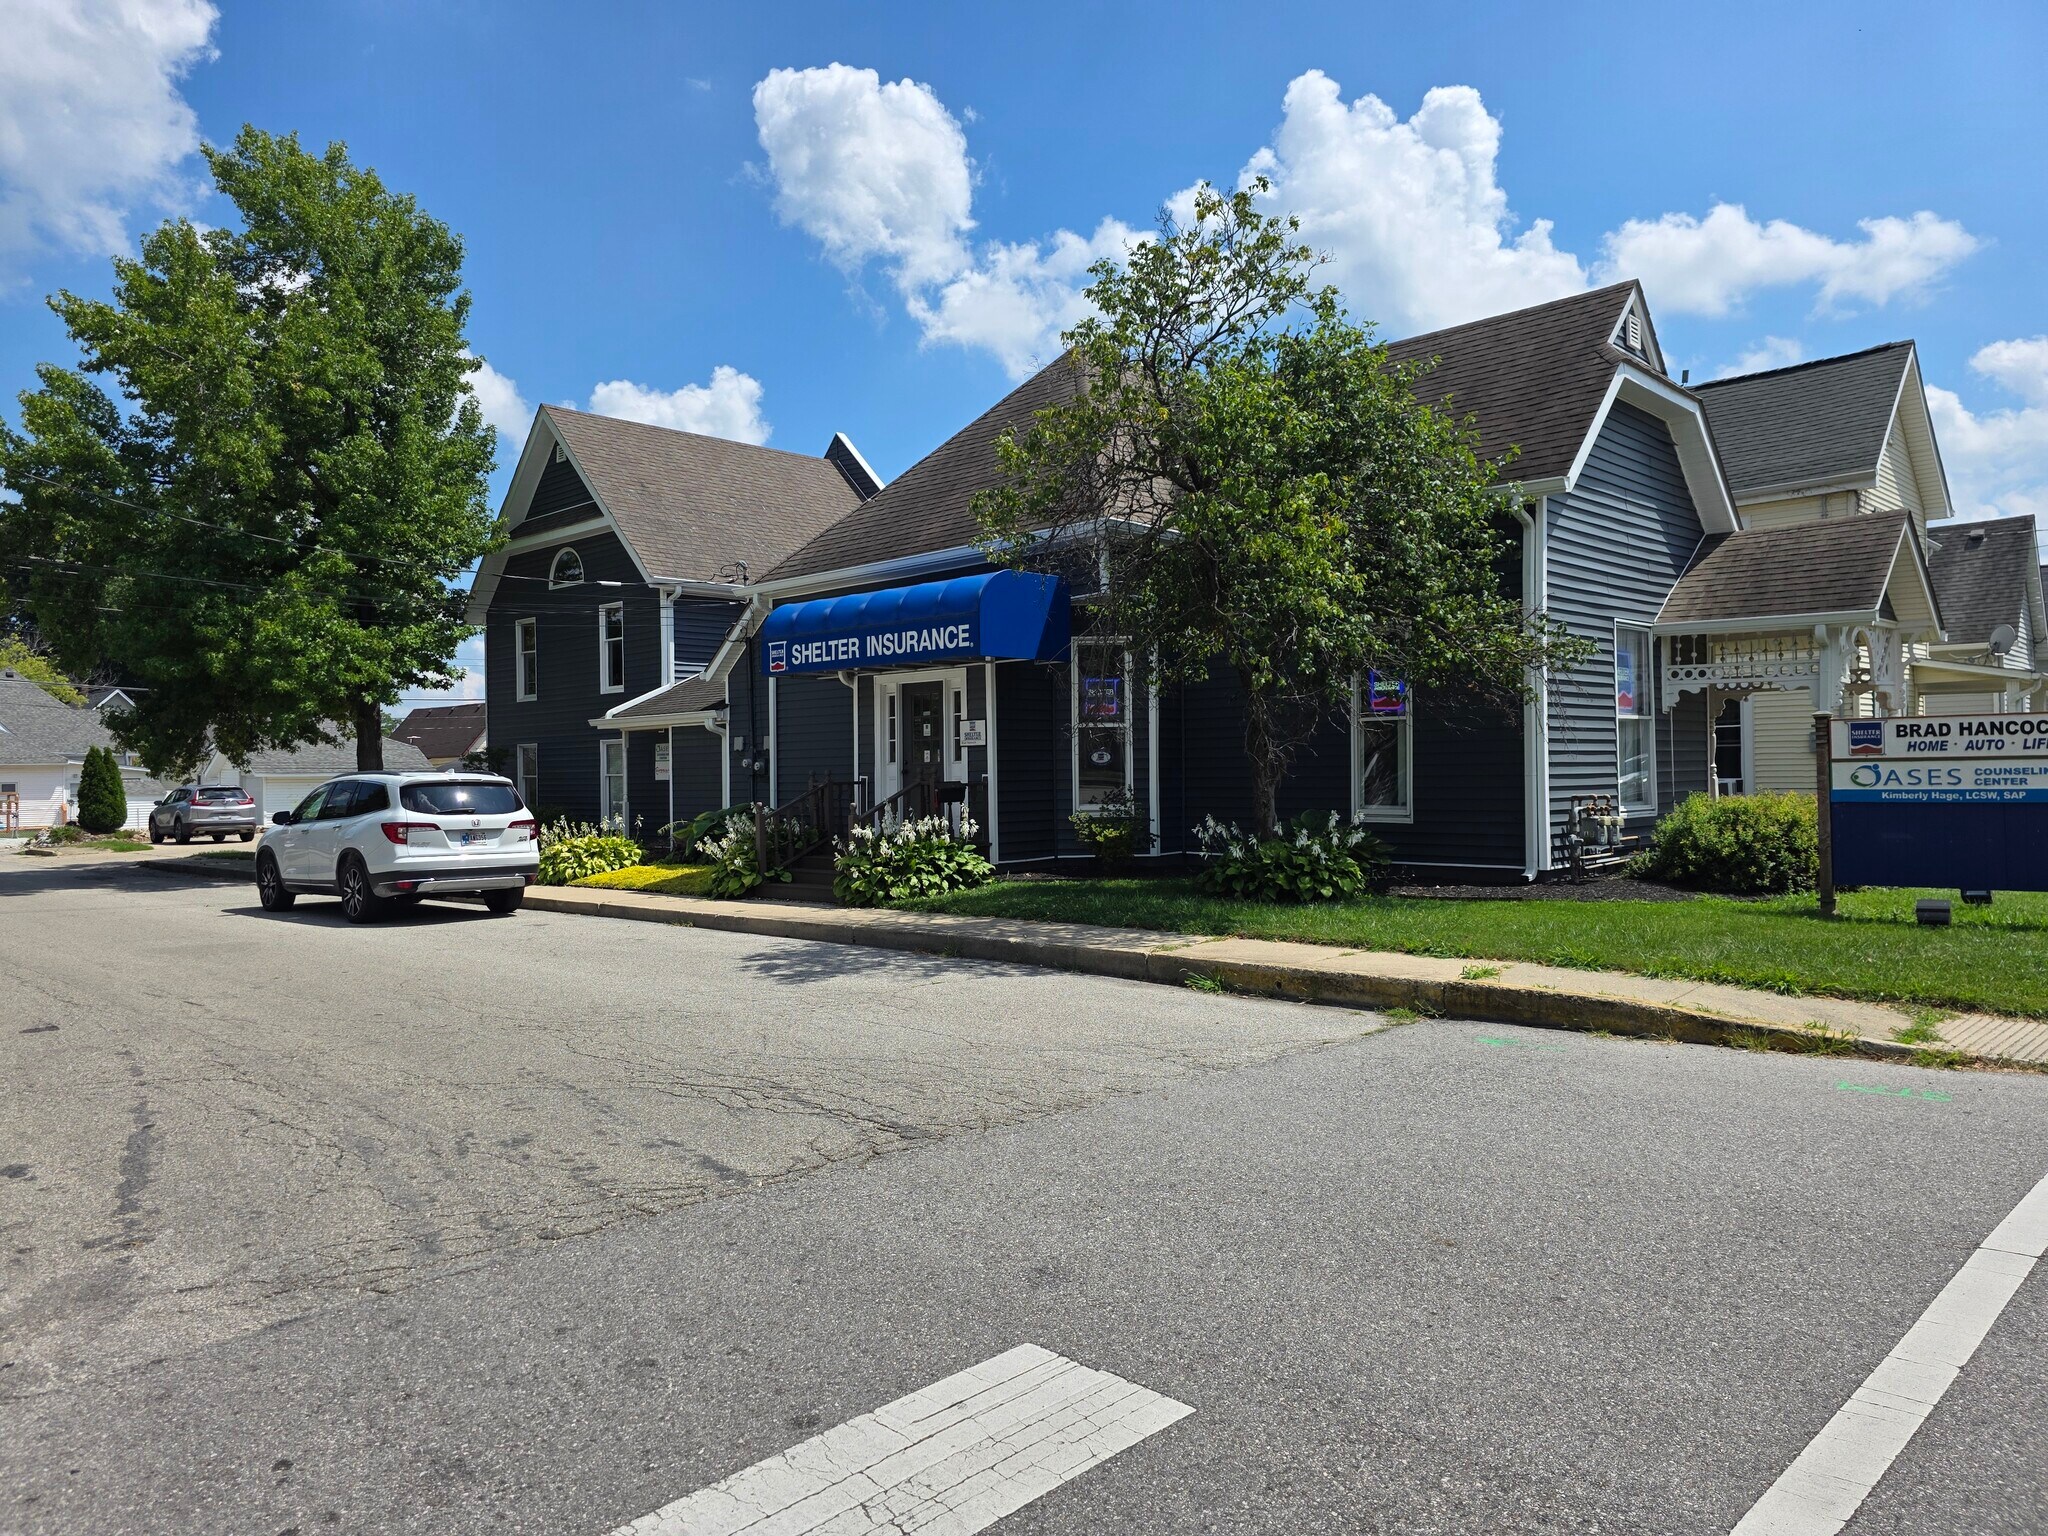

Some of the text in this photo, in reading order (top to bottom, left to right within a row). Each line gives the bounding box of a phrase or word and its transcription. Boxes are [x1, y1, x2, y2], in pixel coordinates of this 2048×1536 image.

[792, 624, 971, 665] SHELTER INSURANCE
[1896, 720, 2048, 738] BRAD HANCOC
[1907, 738, 2048, 752] HOME AUTO LIF
[1974, 777, 2029, 786] CENTER
[1881, 791, 2027, 801] Kimberly Hage, LCSW, SAP
